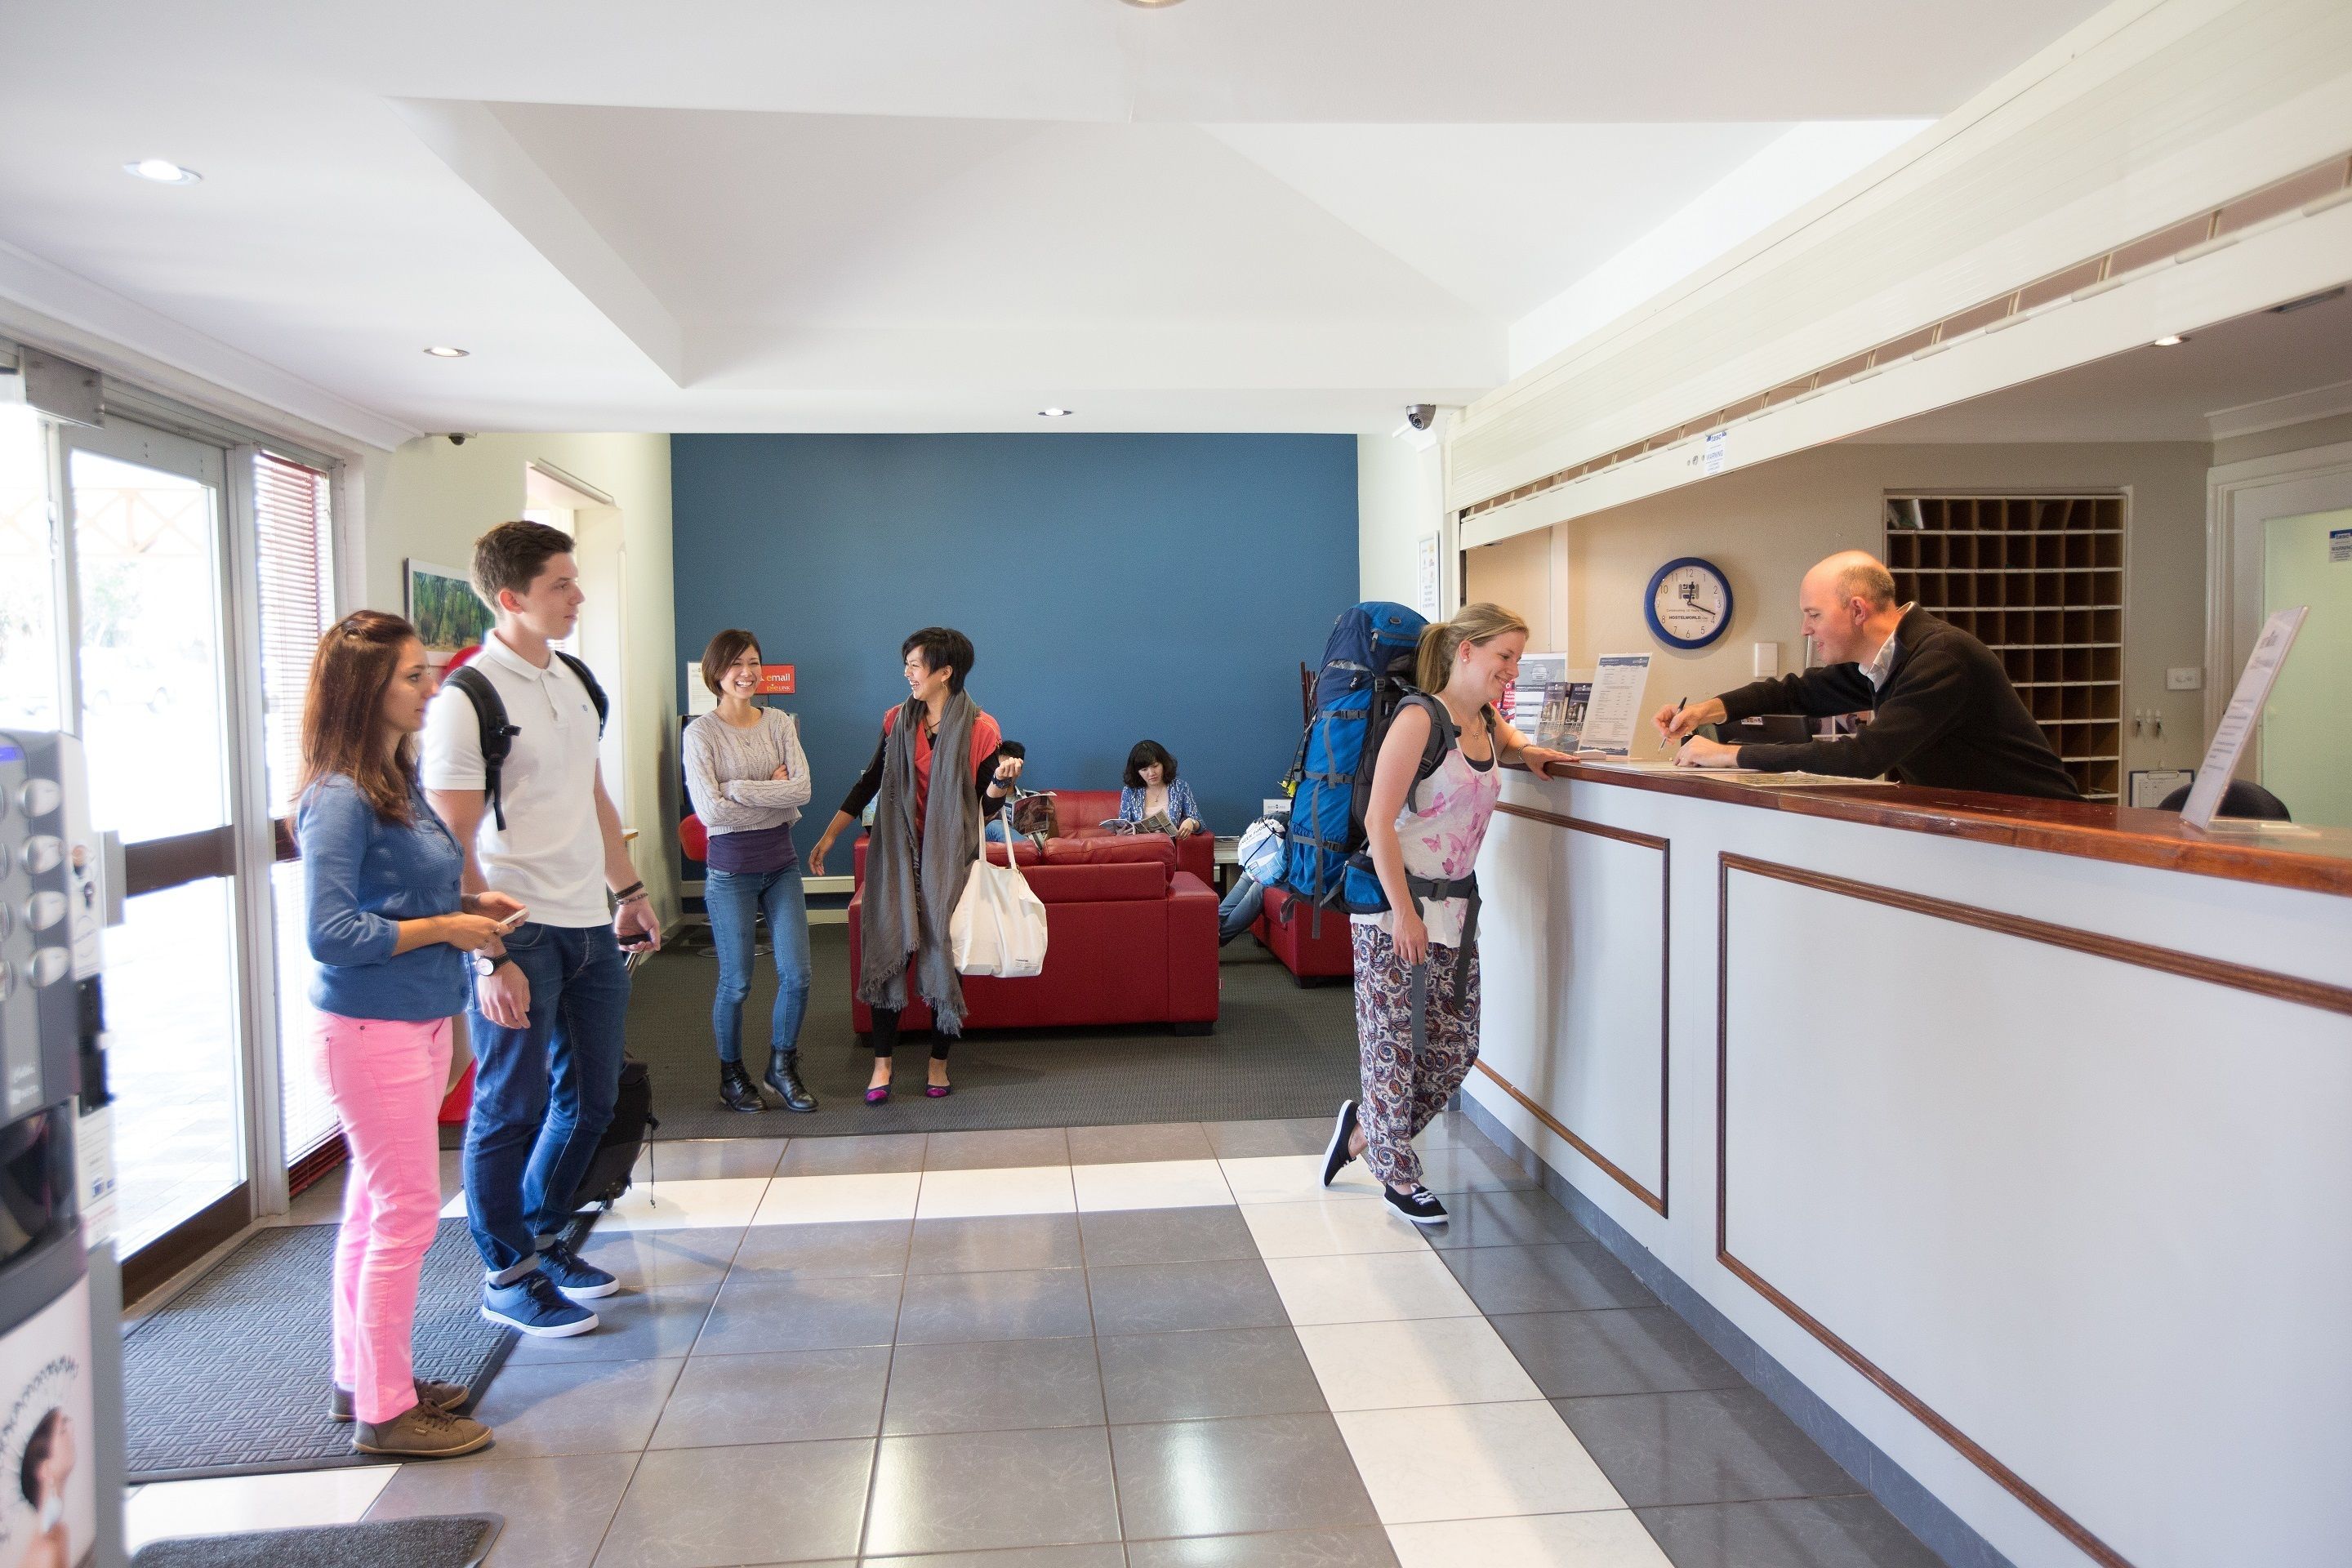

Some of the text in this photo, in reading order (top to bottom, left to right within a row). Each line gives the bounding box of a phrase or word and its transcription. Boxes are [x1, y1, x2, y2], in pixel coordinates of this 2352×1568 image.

[1671, 573, 1678, 581] 11
[1686, 568, 1694, 577] 12
[1703, 573, 1706, 581] 1
[1660, 585, 1668, 594] 10
[1713, 586, 1718, 594] 2
[1662, 615, 1666, 624] 8
[1711, 616, 1715, 624] 4
[1673, 626, 1677, 635] 7
[1686, 630, 1690, 639] 6
[1701, 626, 1705, 635] 5
[766, 673, 791, 681] email
